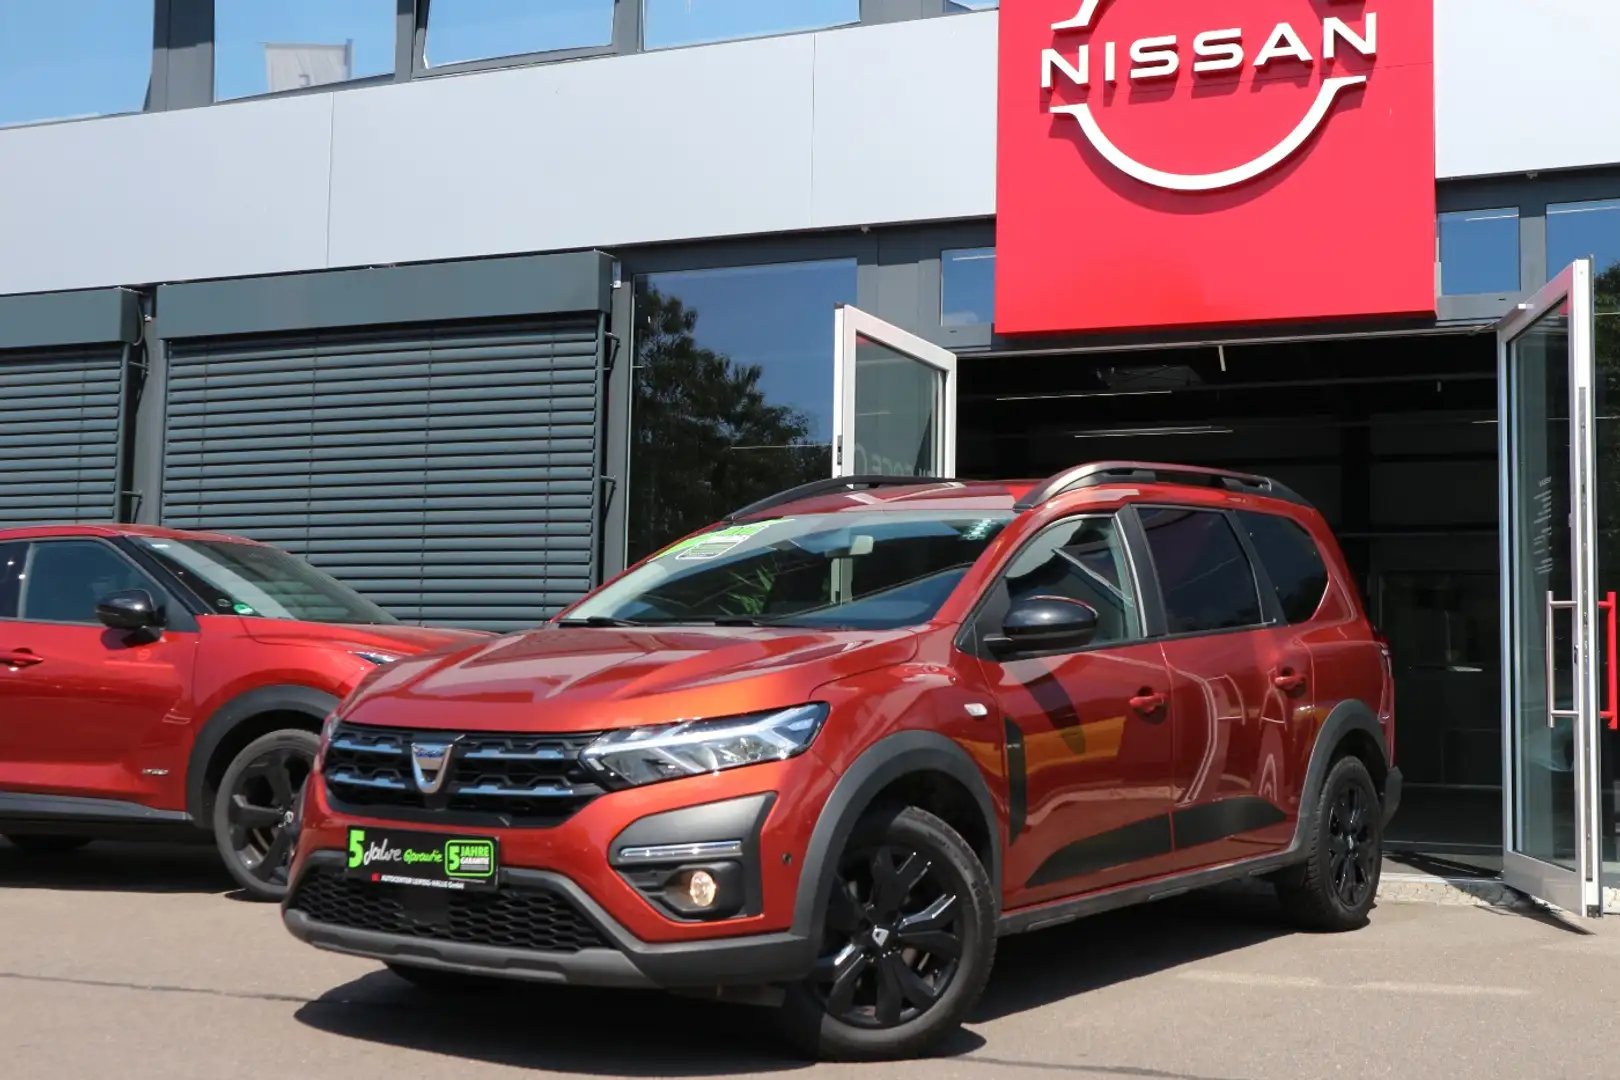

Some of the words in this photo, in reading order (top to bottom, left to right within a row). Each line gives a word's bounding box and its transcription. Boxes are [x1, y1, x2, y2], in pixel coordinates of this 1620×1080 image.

[1041, 12, 1377, 88] NISSAN
[348, 830, 365, 868] 5
[363, 838, 402, 866] Jahre
[403, 848, 443, 864] Garantie
[449, 846, 460, 870] 5
[460, 846, 489, 857] JAHRE
